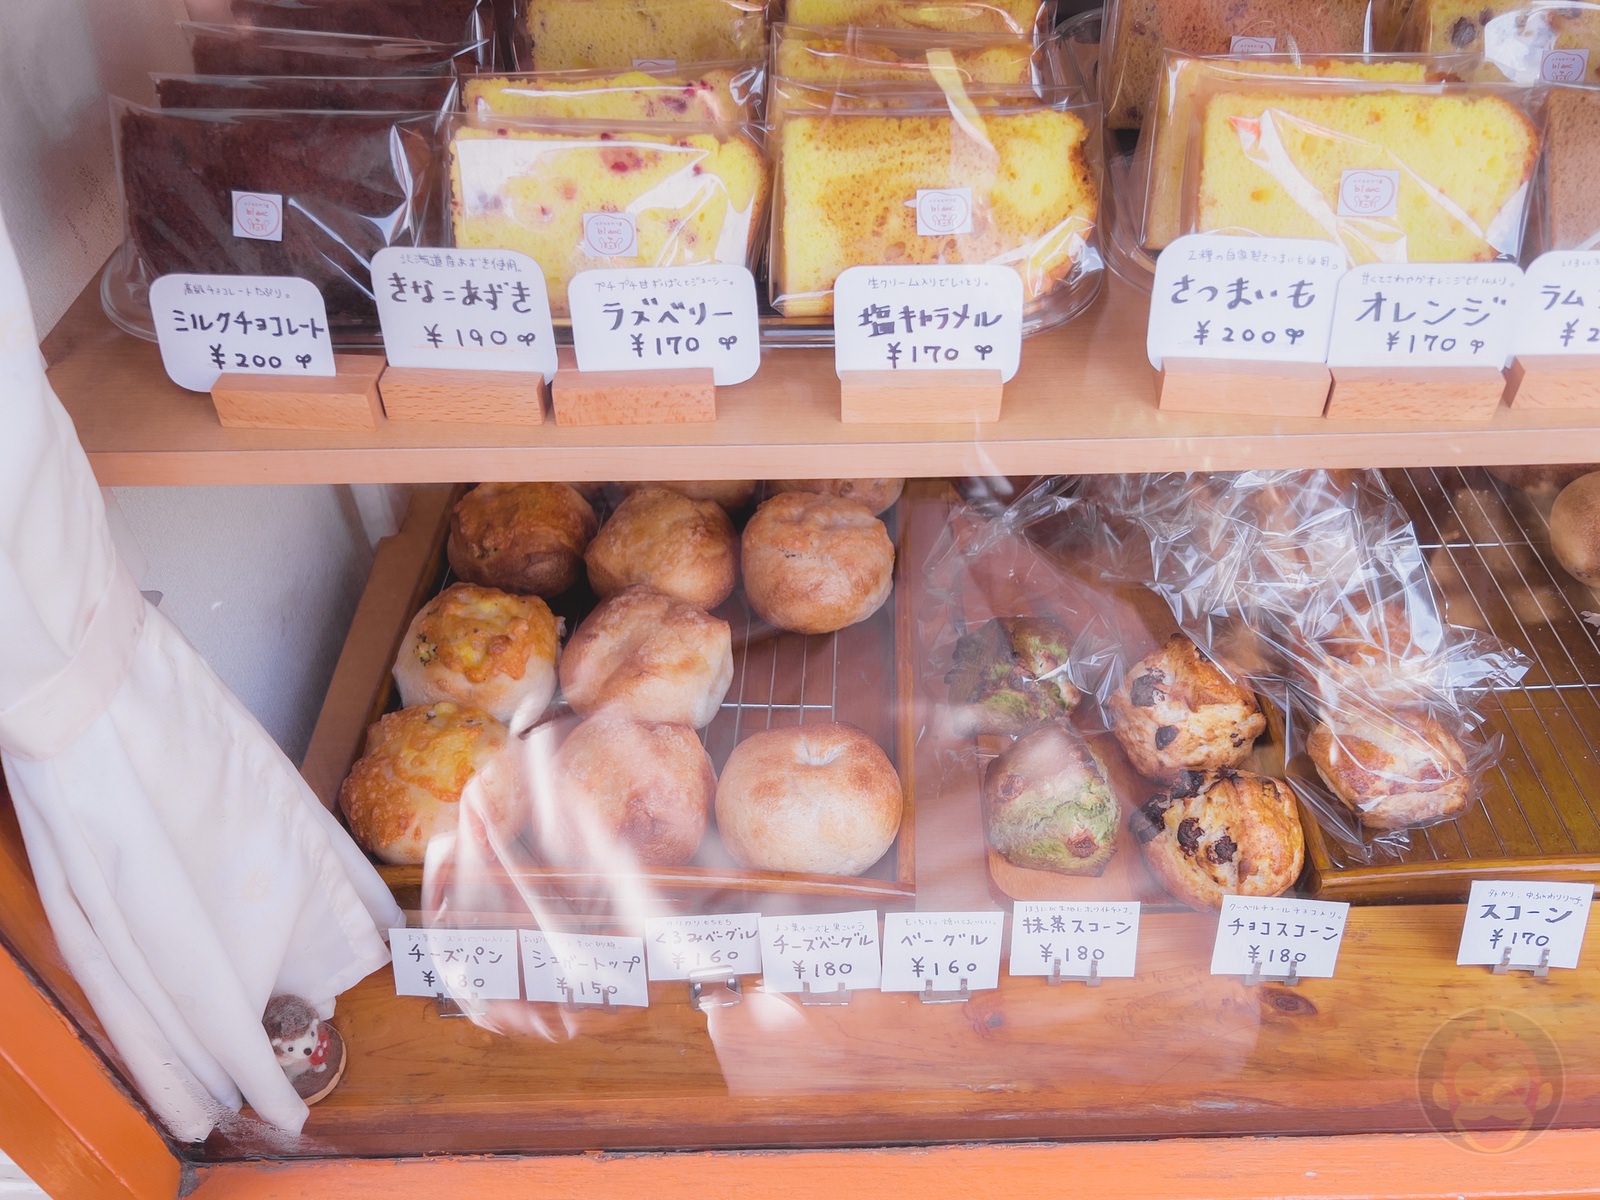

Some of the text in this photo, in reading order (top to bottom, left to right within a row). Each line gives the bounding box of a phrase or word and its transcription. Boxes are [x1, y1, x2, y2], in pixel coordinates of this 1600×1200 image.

[1170, 274, 1316, 310] さつまいも
[601, 297, 734, 331] ラズベリー
[857, 303, 1004, 338] 塩キャラメル
[1354, 291, 1508, 327] オレンジ
[172, 309, 325, 339] ミルクチョコレート
[1193, 319, 1277, 346] ¥200
[423, 323, 508, 349] ¥190
[629, 332, 700, 358] ¥170
[1385, 330, 1456, 353] ¥170
[208, 343, 283, 370] ¥200
[886, 341, 960, 369] ¥170
[1022, 914, 1132, 935] 抹茶スコーン
[1479, 903, 1574, 924] スコーン
[655, 927, 759, 944] くるみベーグル
[900, 931, 989, 947] ベーグル
[1227, 917, 1339, 941] チョコスコーン
[1489, 928, 1550, 950] ¥170
[407, 943, 504, 965] チーズパン
[772, 931, 875, 955] チーズベーグル
[1038, 942, 1105, 963] ¥180
[1247, 944, 1307, 964] ¥180
[531, 949, 642, 974] シュガートップ
[671, 948, 739, 971] ¥160
[791, 959, 854, 980] ¥180
[911, 956, 978, 979] ¥160
[555, 976, 619, 996] ¥150
